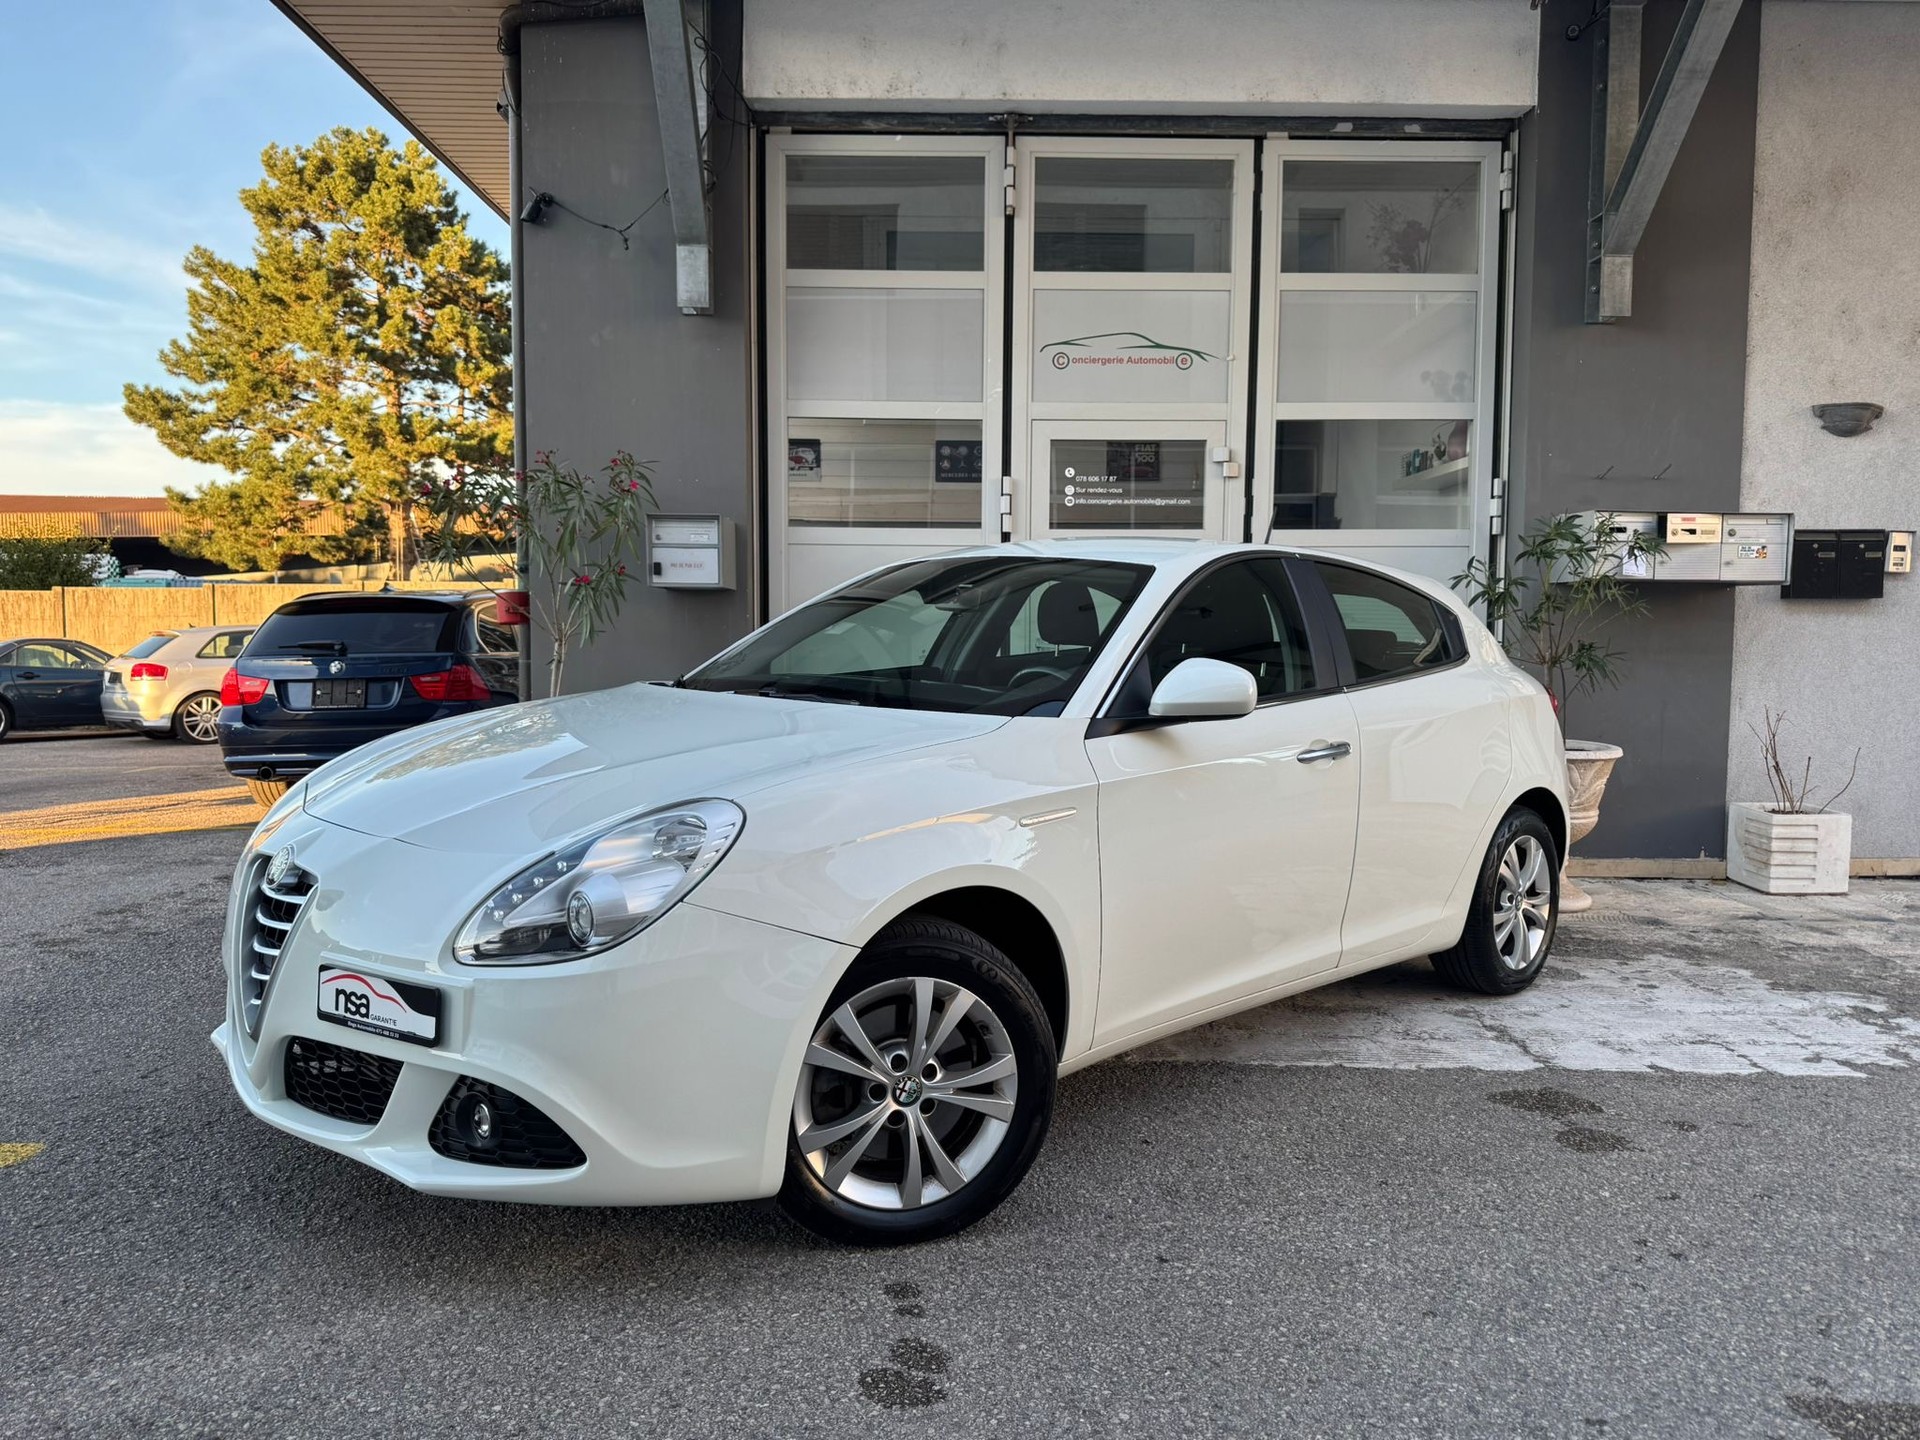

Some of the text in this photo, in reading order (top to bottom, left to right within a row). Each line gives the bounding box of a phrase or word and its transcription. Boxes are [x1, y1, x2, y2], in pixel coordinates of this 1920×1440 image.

[1054, 353, 1191, 368] Conciergerie Automobile
[1135, 444, 1157, 452] FIAT
[335, 988, 370, 1019] nsa
[370, 1013, 398, 1026] GARANTIE
